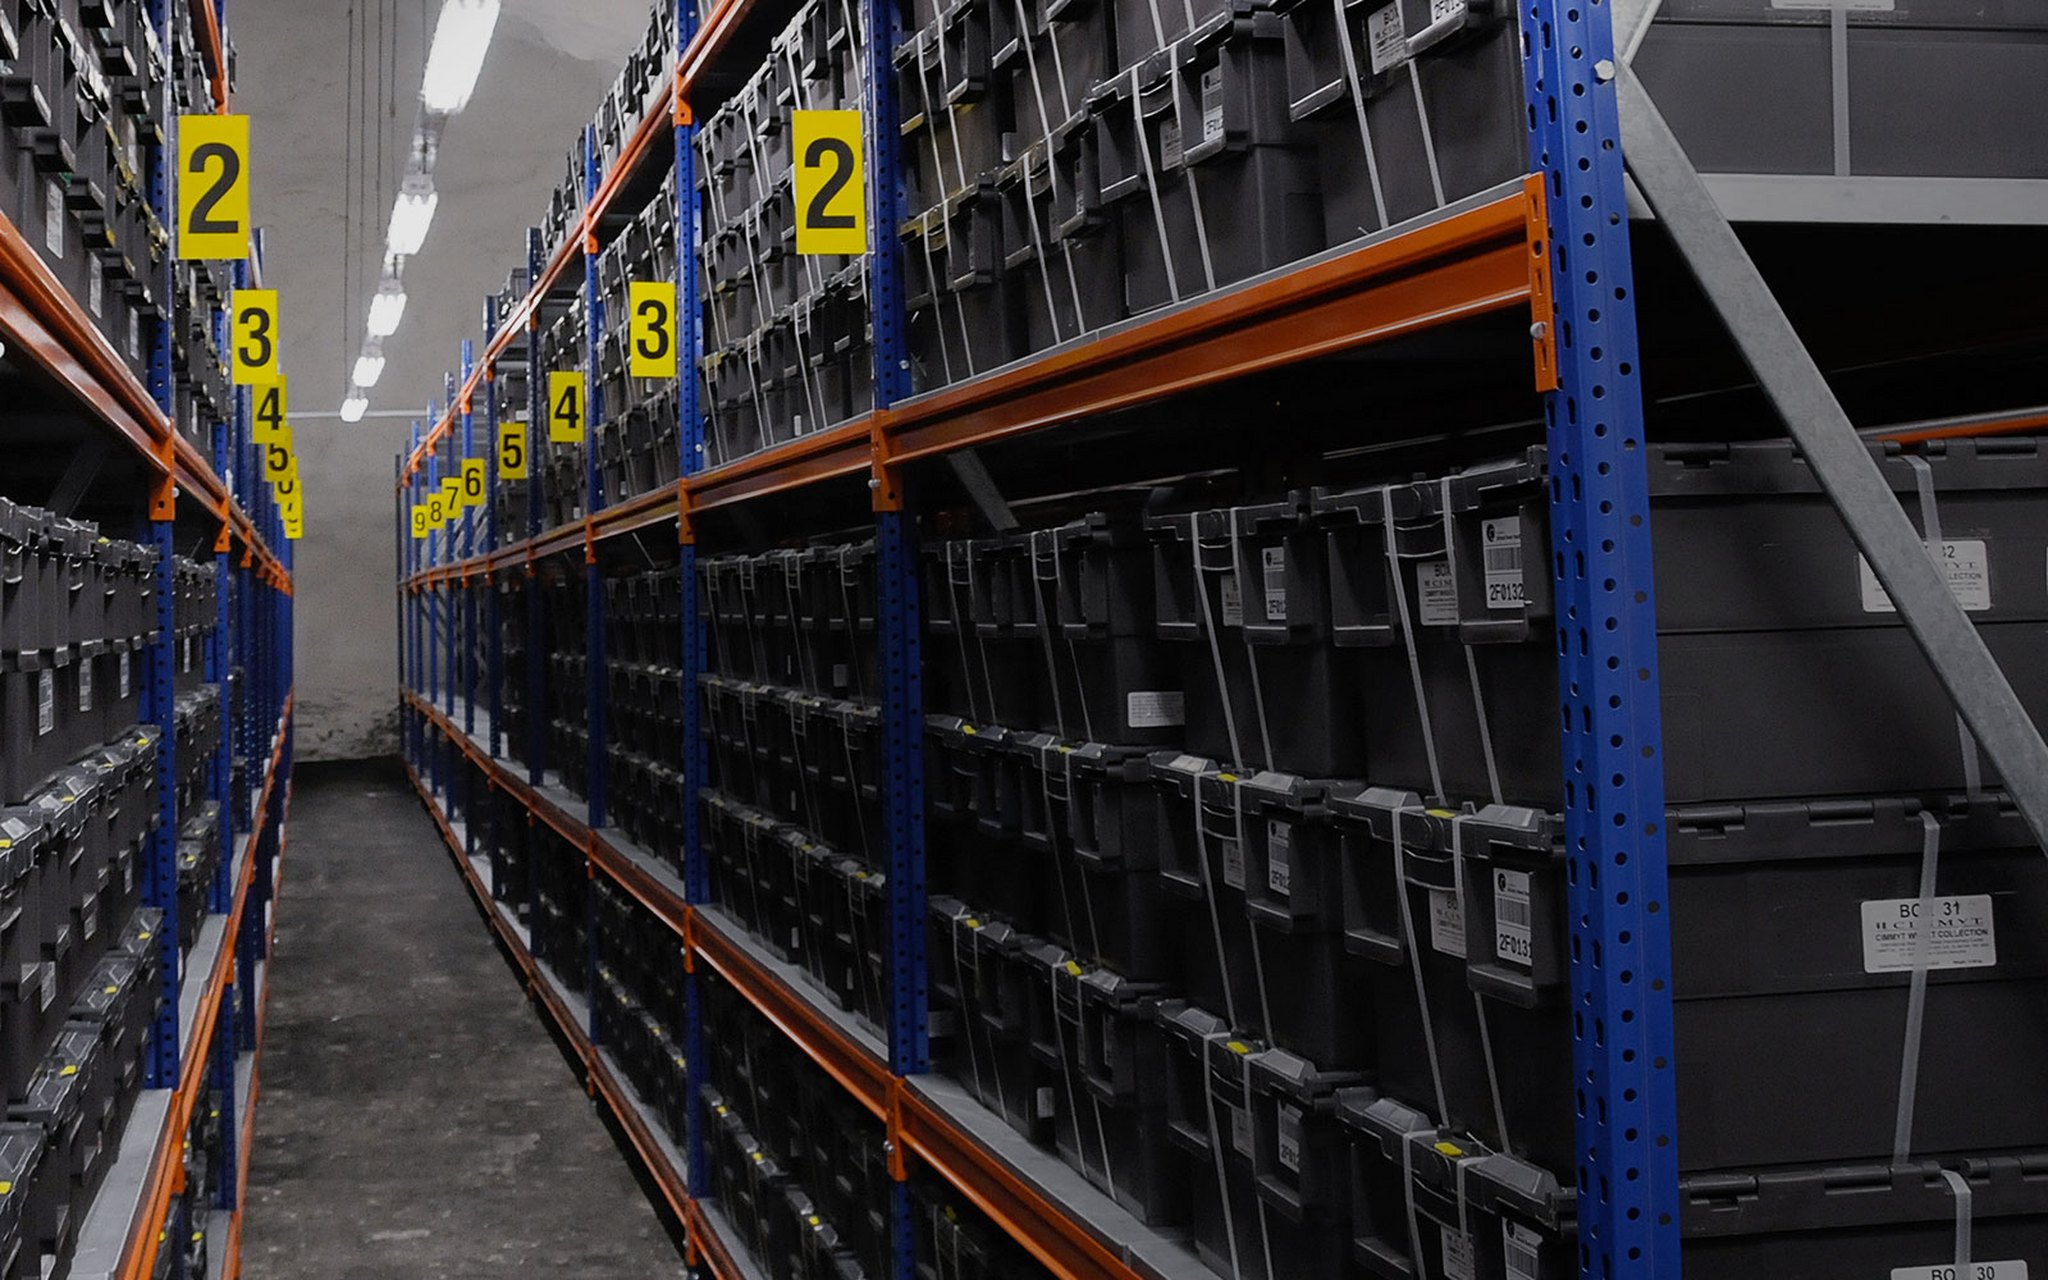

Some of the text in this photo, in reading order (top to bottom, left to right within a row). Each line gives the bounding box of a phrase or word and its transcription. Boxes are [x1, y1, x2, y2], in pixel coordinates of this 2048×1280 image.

[189, 142, 239, 233] 2
[805, 138, 855, 228] 2
[239, 307, 271, 368] 3
[637, 300, 669, 360] 3
[257, 387, 282, 430] 4
[554, 385, 581, 429] 4
[269, 443, 288, 472] 5
[503, 433, 522, 469] 5
[465, 468, 481, 497] 6
[430, 501, 442, 522] 8
[445, 486, 459, 510] 7
[415, 512, 425, 531] 9
[1489, 583, 1525, 601] 2F0132
[1900, 901, 1960, 917] BO 31
[1931, 1266, 1995, 1280] BO 30
